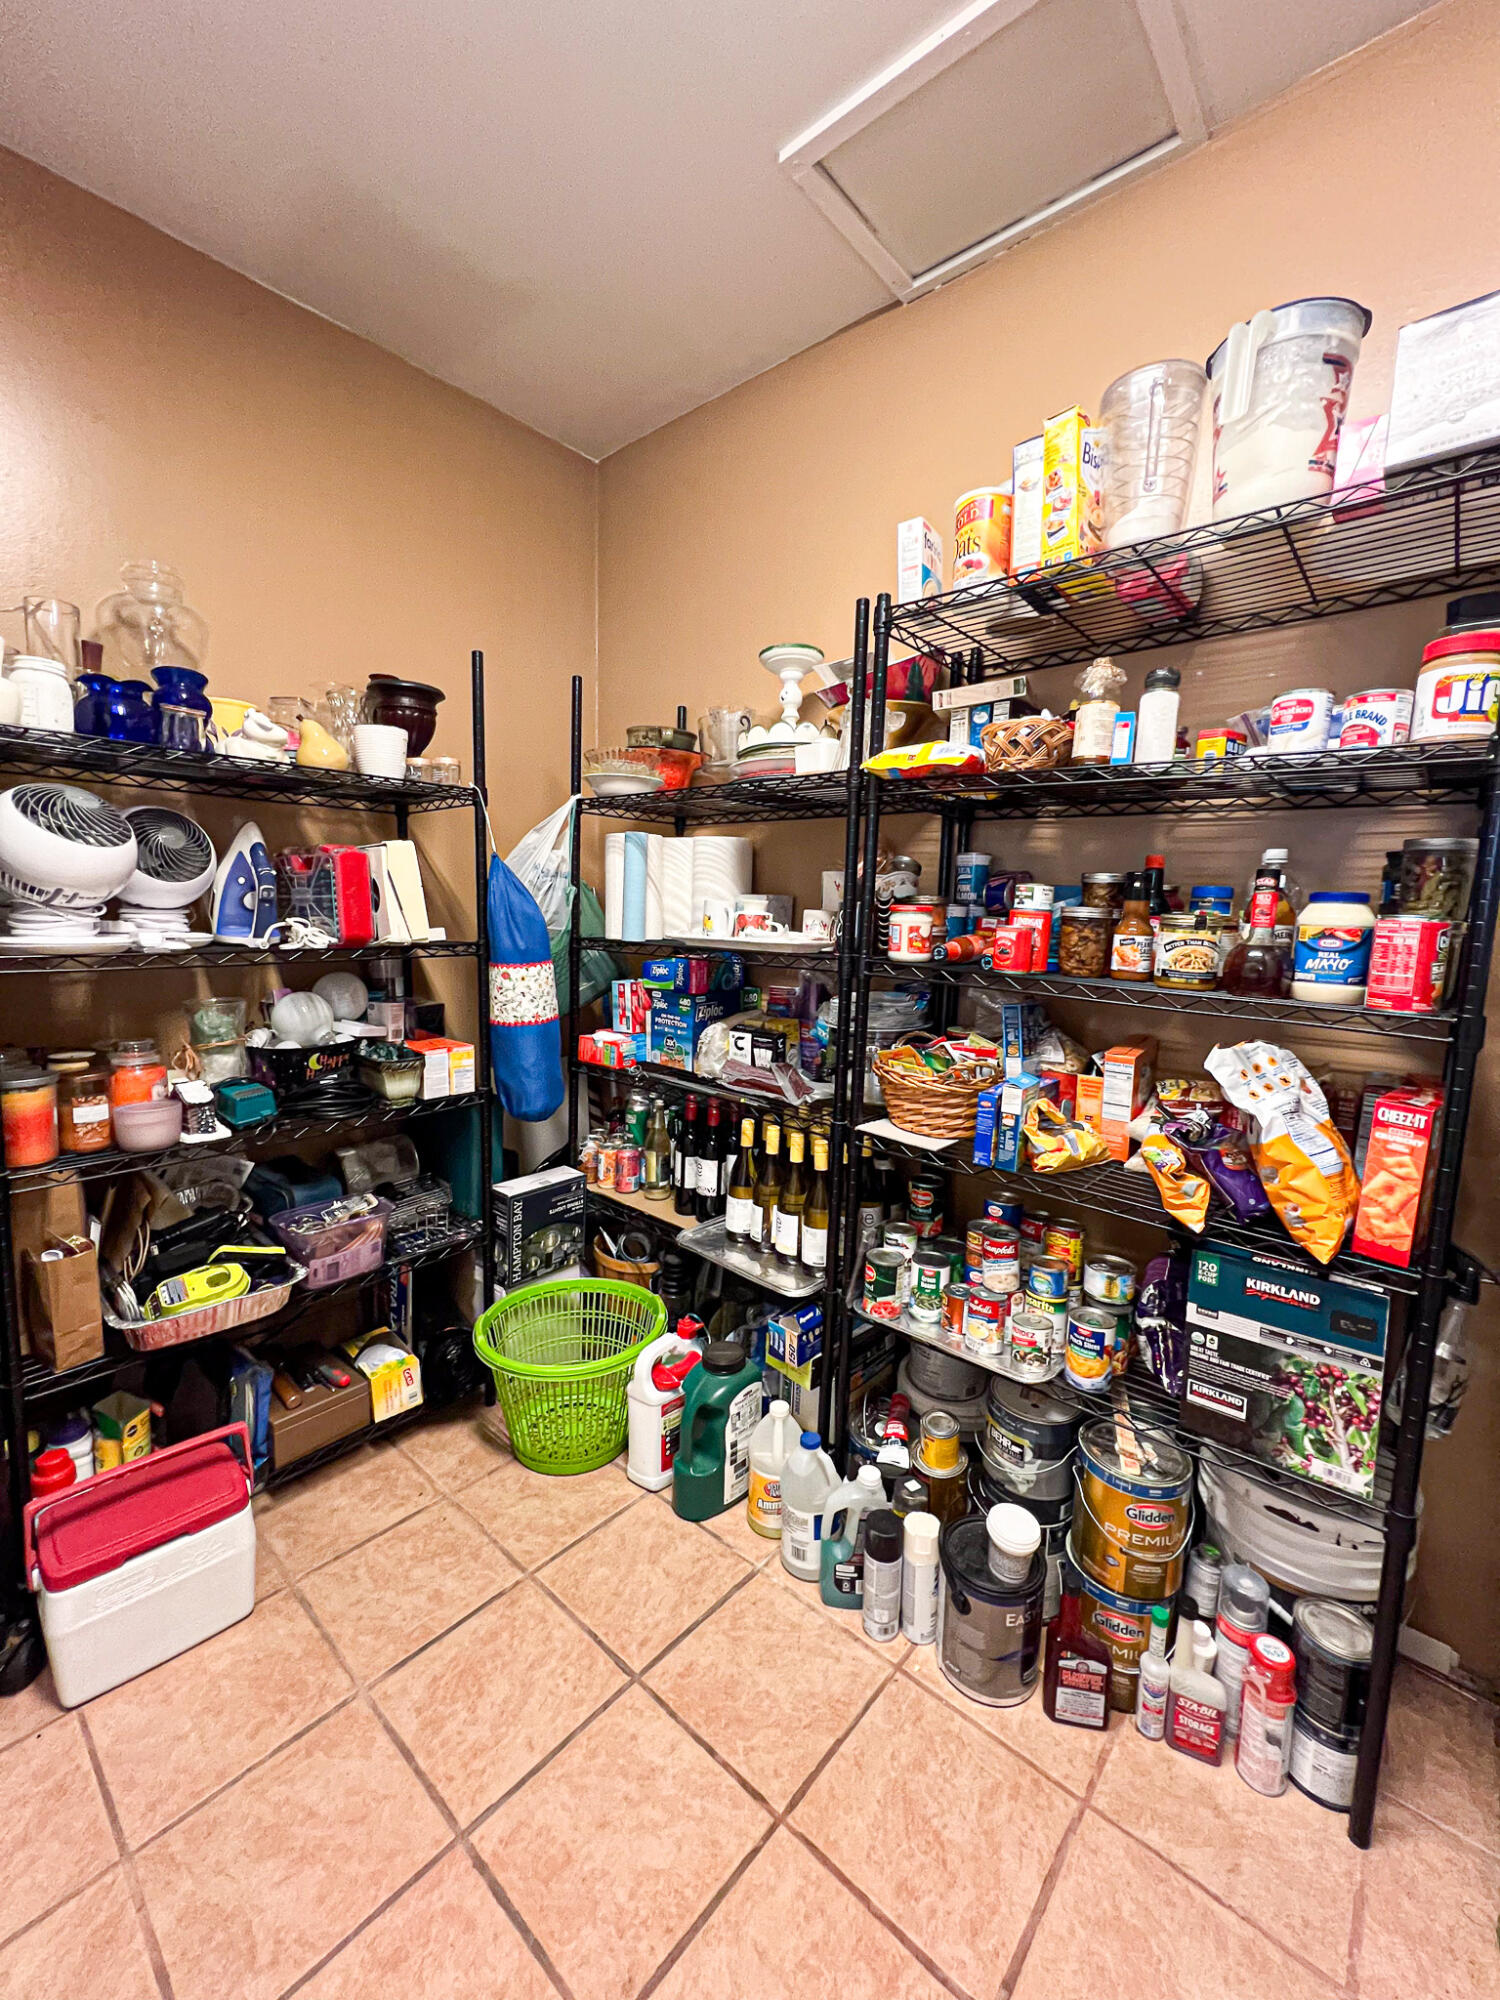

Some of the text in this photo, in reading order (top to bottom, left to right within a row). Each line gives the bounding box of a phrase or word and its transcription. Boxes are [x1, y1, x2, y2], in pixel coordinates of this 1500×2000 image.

[1436, 679, 1497, 714] Jif
[1355, 709, 1388, 727] BRAND
[1317, 951, 1341, 959] REAL
[650, 964, 670, 977] Ziploc
[1304, 958, 1355, 971] MAYO
[676, 962, 685, 987] Ziploc
[652, 998, 669, 1010] Ziploc
[678, 997, 691, 1007] 480
[695, 1003, 724, 1023] Ziploc
[654, 1017, 688, 1029] PROTECTION
[319, 1053, 350, 1068] Happy
[1377, 1107, 1428, 1129] CHEEZ-IT
[512, 1200, 524, 1283] HAMPTON BAY
[983, 1240, 1017, 1256] Campbell's
[1198, 1260, 1218, 1273] 120
[1197, 1275, 1217, 1285] PODS
[1245, 1277, 1321, 1306] KIRKLAND
[788, 1344, 796, 1364] 150
[1192, 1383, 1243, 1407] KIRKLAND
[1126, 1507, 1175, 1525] Glidden
[1093, 1612, 1145, 1639] Glidden
[1177, 1697, 1218, 1718] STA-BIL
[1178, 1715, 1215, 1735] STORAGE
